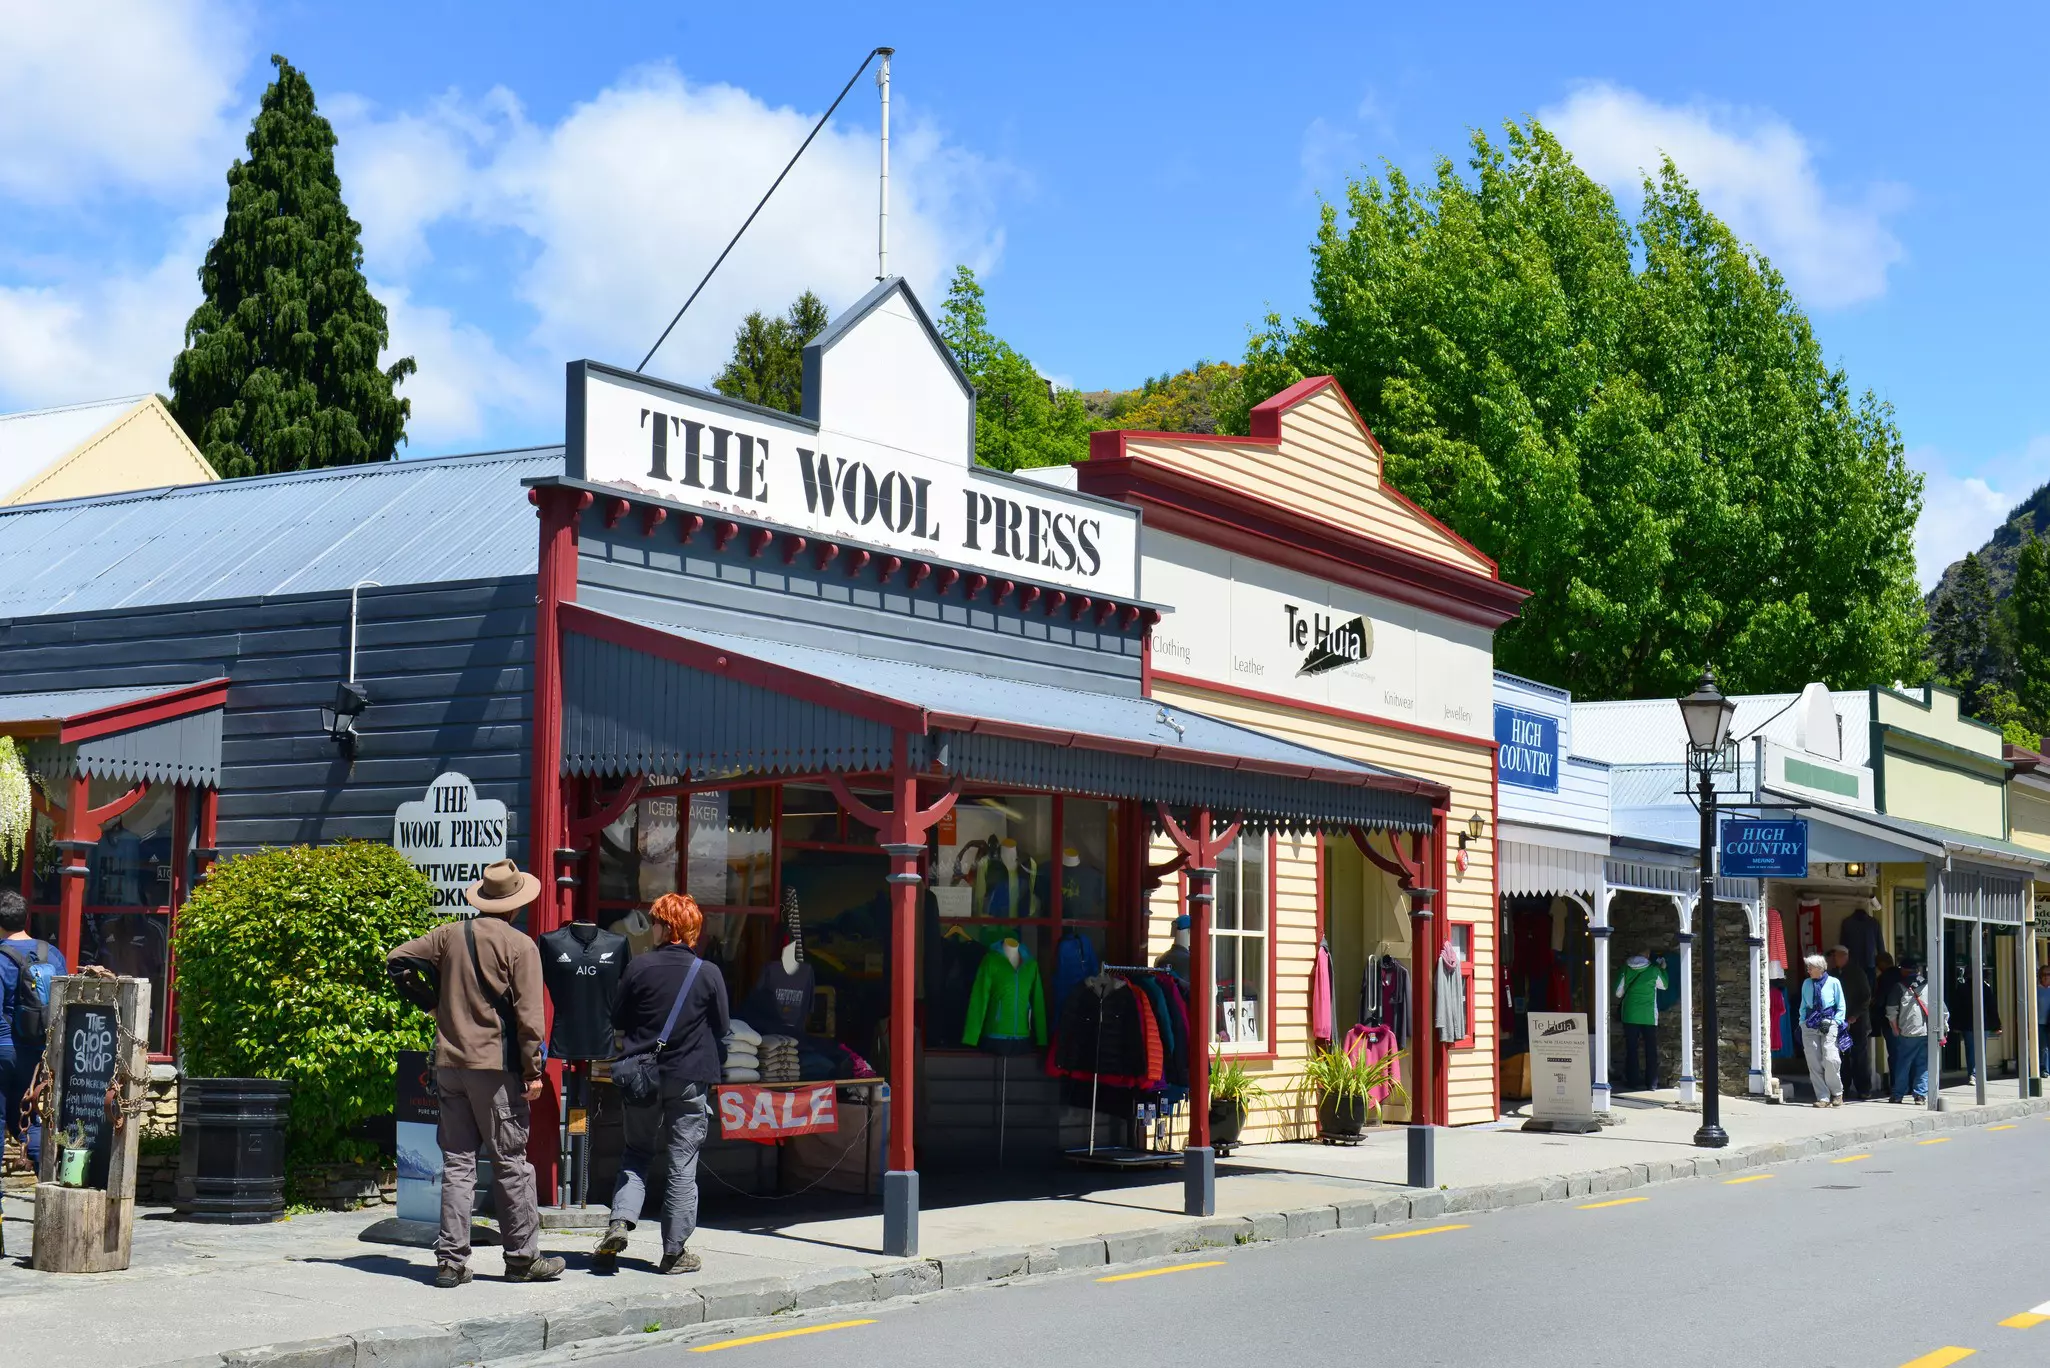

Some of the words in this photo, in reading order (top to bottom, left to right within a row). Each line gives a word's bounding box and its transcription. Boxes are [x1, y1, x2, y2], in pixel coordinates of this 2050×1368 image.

[641, 408, 769, 503] THE
[796, 447, 939, 541] WOOL
[962, 489, 1101, 576] PRESS
[1285, 604, 1308, 645] Te
[1315, 613, 1361, 660] Huia
[1153, 636, 1190, 665] Clothing
[1234, 655, 1264, 675] Leather
[1384, 690, 1413, 709] Knitwear
[1444, 704, 1472, 726] Jewellery
[1512, 718, 1542, 747] HIGH
[1500, 744, 1553, 776] COUNTRY
[433, 786, 468, 813] THE
[400, 820, 443, 848] WOOL
[450, 819, 503, 848] PRESS
[1742, 828, 1784, 840] HIGH
[1726, 842, 1802, 855] COUNTRY
[576, 966, 597, 976] AIG
[85, 1013, 107, 1030] THE
[1533, 1020, 1544, 1030] Te
[1547, 1020, 1573, 1031] Huia
[73, 1029, 112, 1053] CHOP
[75, 1053, 112, 1073] SHOP
[720, 1087, 834, 1130] SALE
